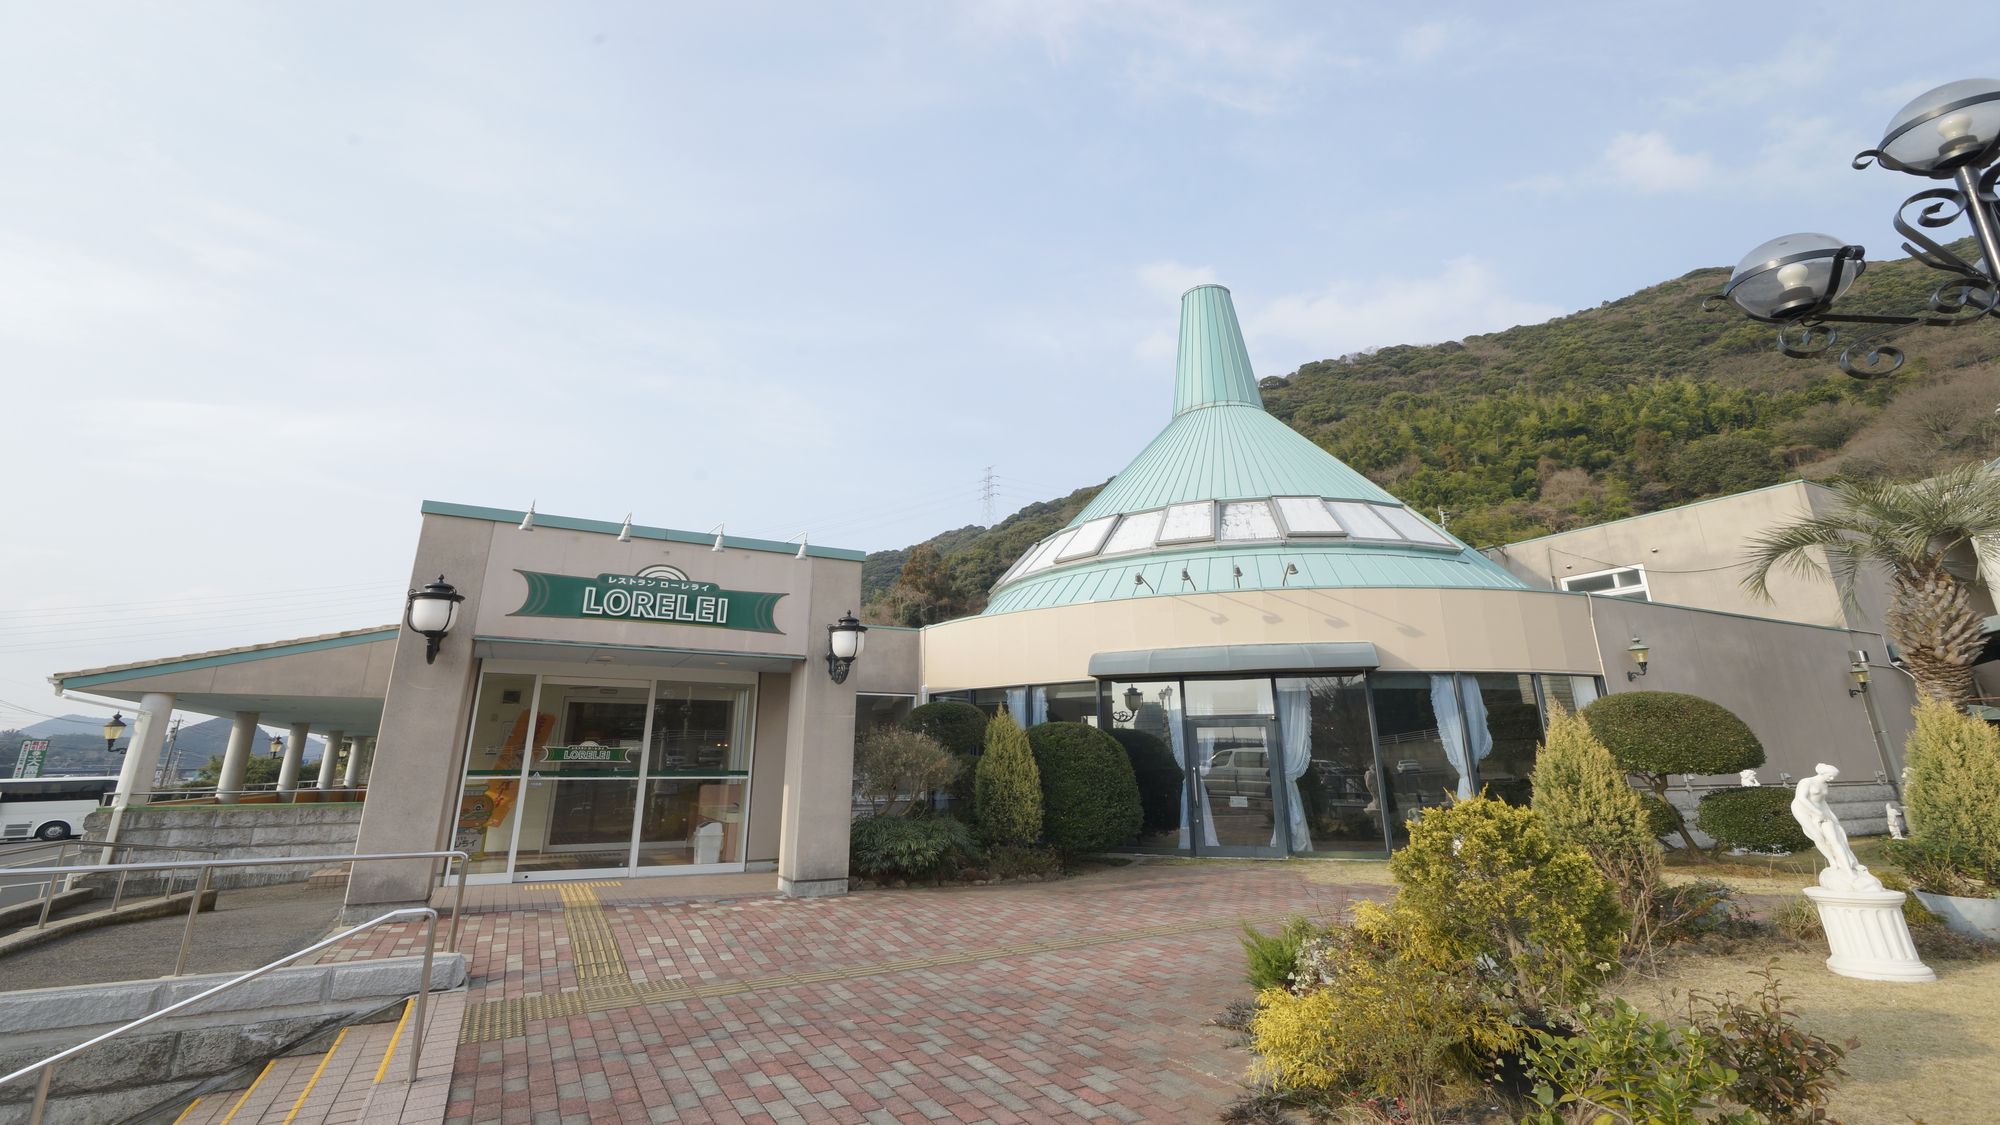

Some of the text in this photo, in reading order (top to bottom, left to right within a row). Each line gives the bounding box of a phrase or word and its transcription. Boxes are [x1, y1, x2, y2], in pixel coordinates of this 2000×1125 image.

[608, 576, 709, 591] レストラン ローレライ
[582, 587, 728, 623] LORELEI
[564, 750, 610, 759] LORELEI
